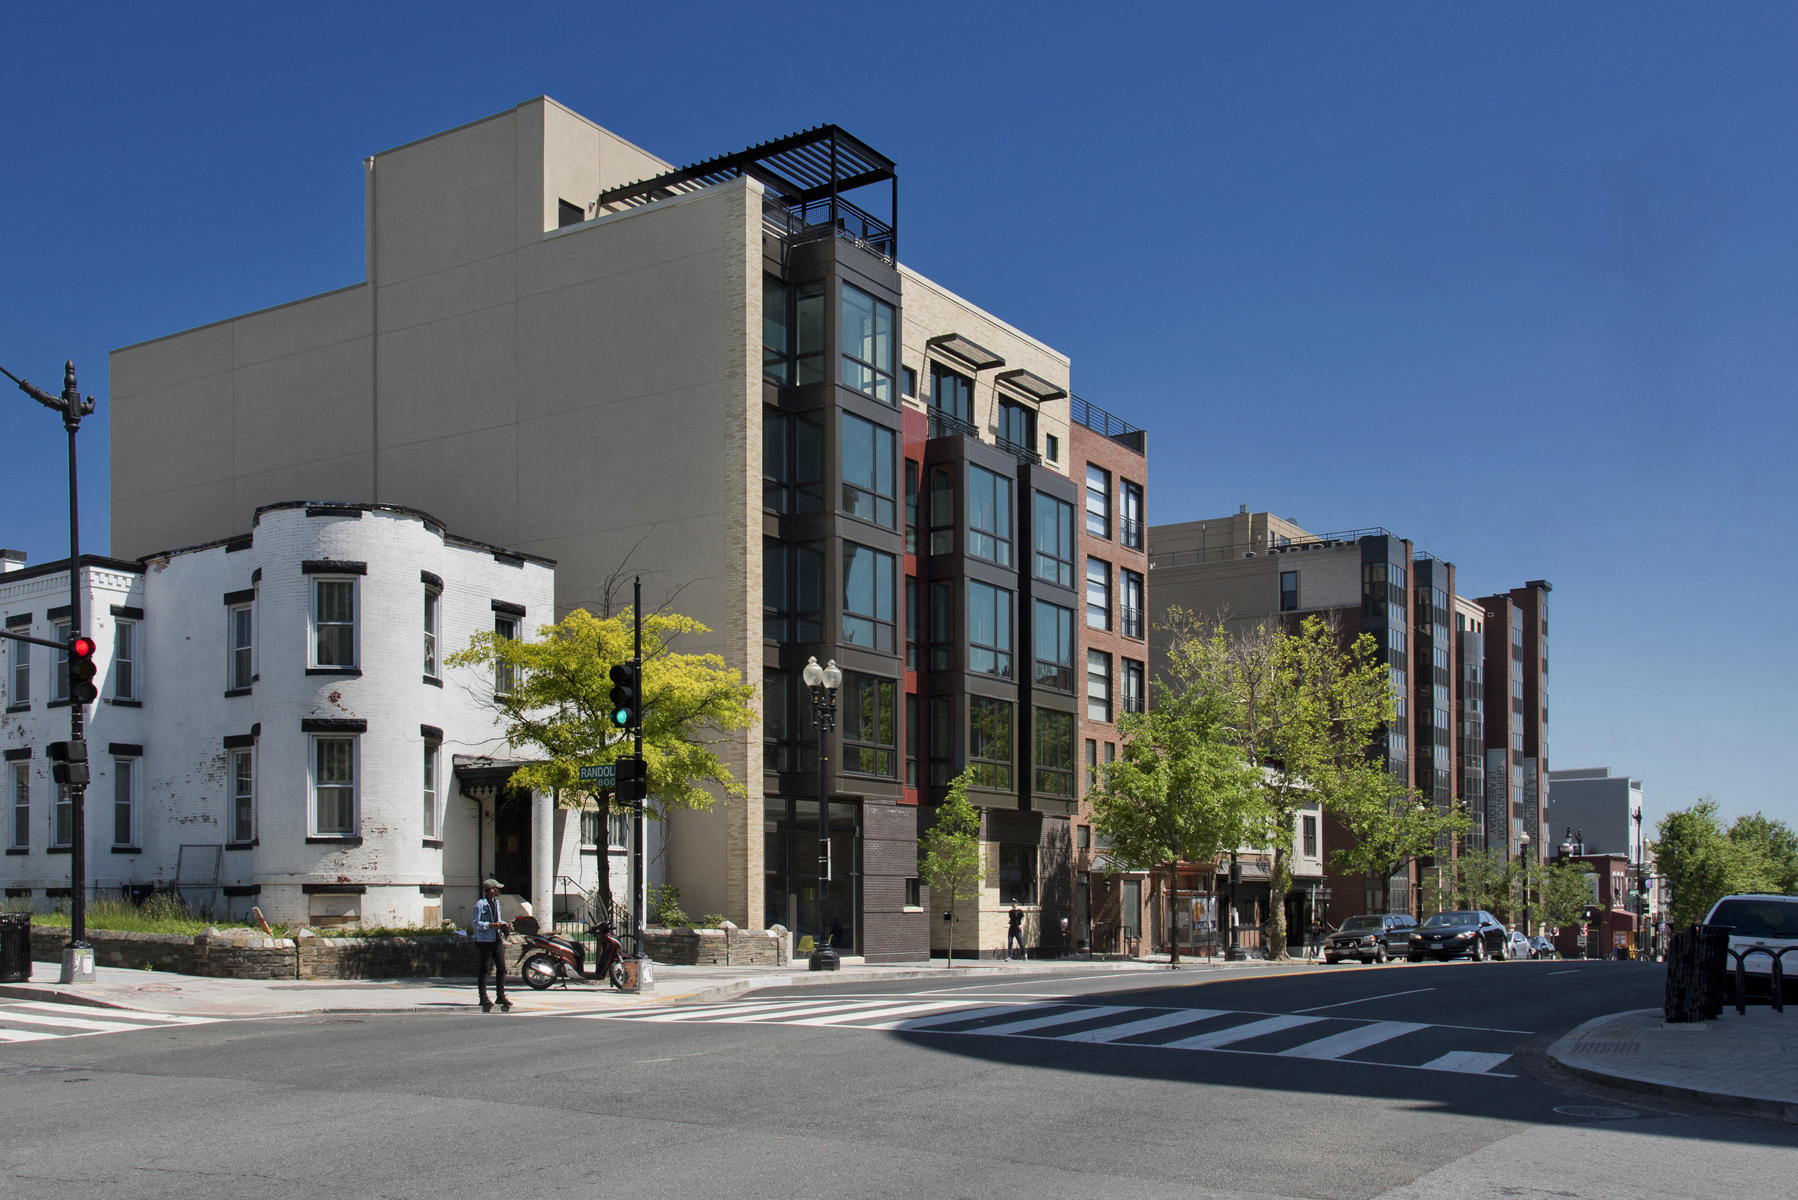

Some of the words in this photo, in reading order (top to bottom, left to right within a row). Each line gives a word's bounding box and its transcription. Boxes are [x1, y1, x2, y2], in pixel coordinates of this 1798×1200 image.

[581, 767, 616, 778] RANDOL
[1488, 771, 1496, 801] LEASE
[1497, 766, 1505, 840] GRIFFINDC.COM
[1488, 805, 1496, 835] TODAY
[1528, 795, 1536, 846] BEDROOMS
